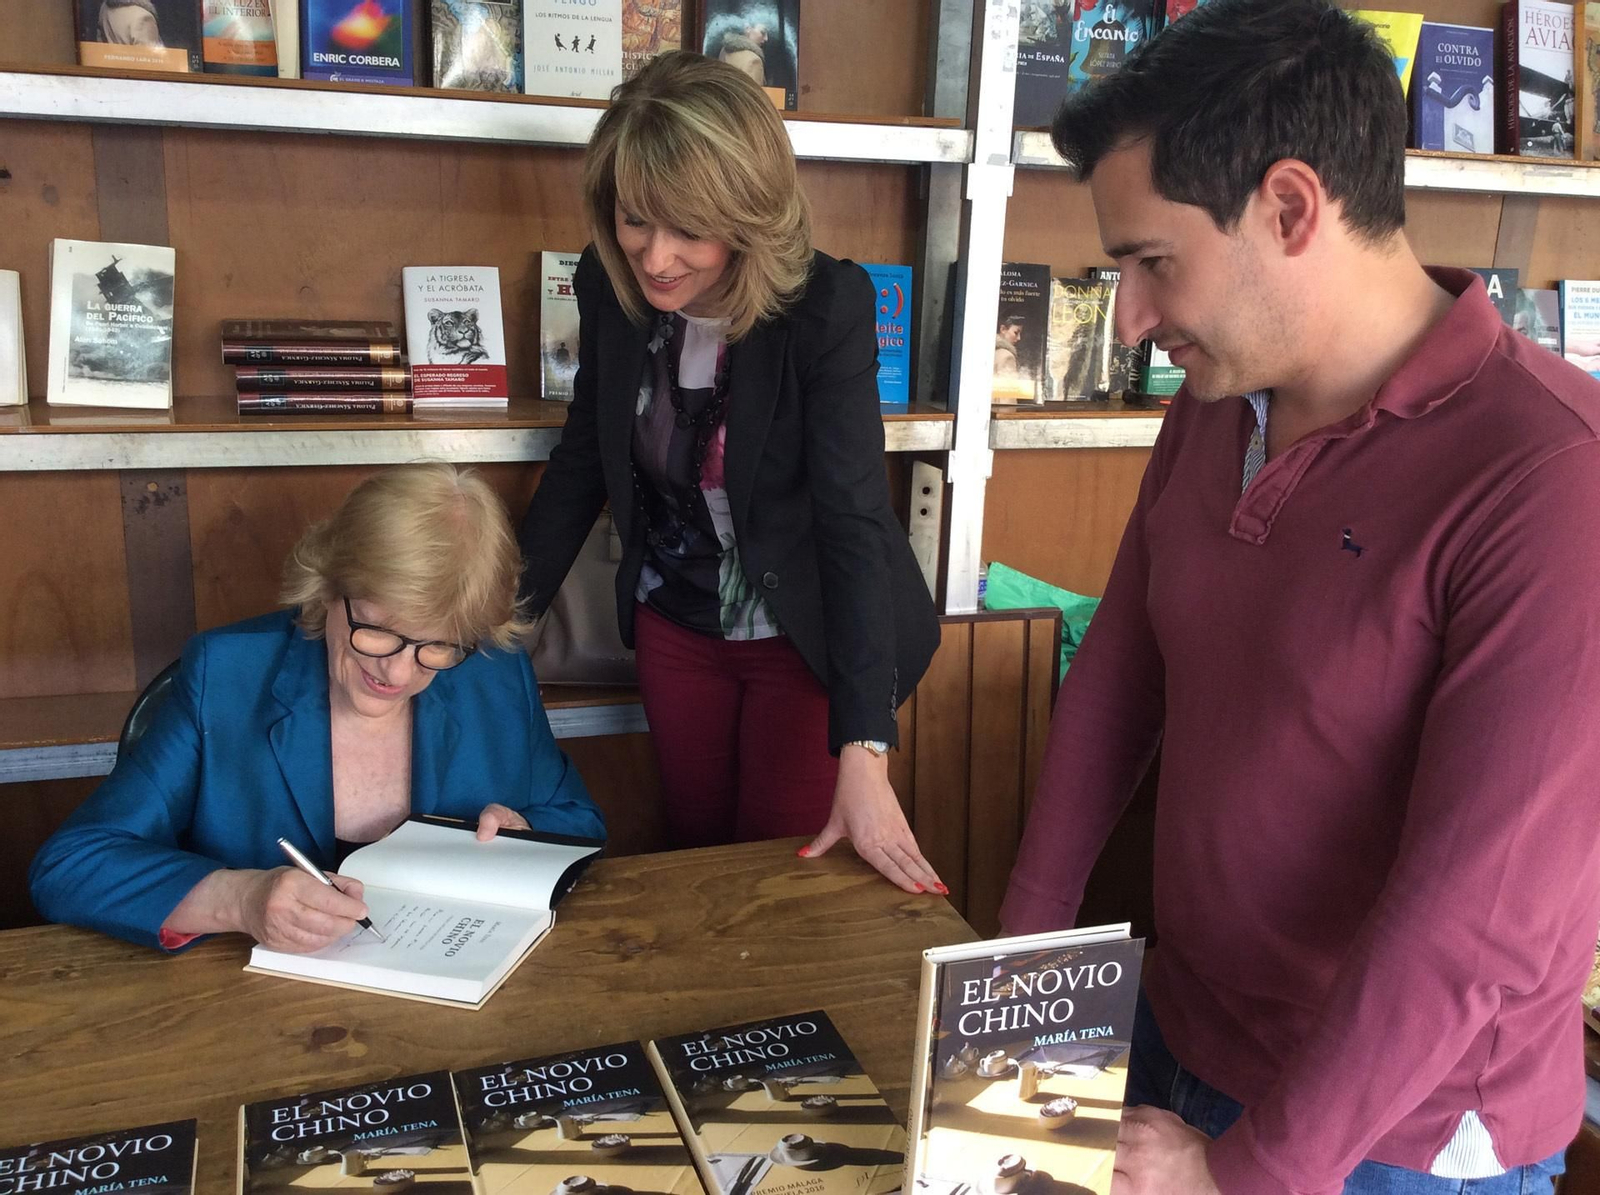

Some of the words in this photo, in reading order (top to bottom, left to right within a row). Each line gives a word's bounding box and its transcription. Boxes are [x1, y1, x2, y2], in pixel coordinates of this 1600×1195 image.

[1103, 4, 1117, 24] El
[1074, 20, 1139, 42] Encanto
[1525, 27, 1575, 51] AVIA
[1437, 42, 1480, 56] CONTRA
[313, 53, 347, 63] ENRIC
[348, 55, 400, 67] CORBERA
[554, 65, 586, 75] ANTONIO
[1443, 54, 1482, 67] OLVIDO
[1507, 65, 1515, 77] LA
[438, 283, 485, 292] ACRÓBATA
[439, 275, 475, 283] TIGRESA
[1053, 284, 1115, 300] DONNA
[86, 312, 104, 321] DEL
[108, 311, 153, 323] PACÍFICO
[104, 303, 143, 313] GUERRA
[1052, 303, 1108, 324] LEON
[1573, 311, 1582, 319] EL
[441, 917, 472, 945] CHINO
[470, 919, 485, 929] EL
[444, 929, 476, 958] NOVIO
[961, 978, 1001, 1006] EL
[1010, 961, 1122, 999] NOVIO
[958, 998, 1075, 1036] CHINO
[681, 1039, 718, 1057] EL
[720, 1021, 818, 1049] NOVIO
[1033, 1029, 1077, 1048] MARÍA
[1079, 1025, 1114, 1040] TENA
[690, 1043, 789, 1072] CHINO
[765, 1059, 802, 1073] MARÍA
[803, 1053, 836, 1064] TENA
[479, 1073, 518, 1091] EL
[523, 1053, 628, 1083] NOVIO
[484, 1077, 593, 1107] CHINO
[563, 1094, 603, 1108] MARÍA
[606, 1087, 641, 1099] TENA
[271, 1106, 311, 1124] EL
[320, 1083, 432, 1116] NOVIO
[271, 1109, 390, 1141] CHINO
[353, 1126, 398, 1141] MARÍA
[401, 1119, 438, 1132] TENA
[46, 1134, 173, 1168] NOVIO
[74, 1182, 124, 1195] MARÍA
[128, 1175, 169, 1188] TENA
[787, 1177, 824, 1190] MÁLAGA
[805, 1185, 825, 1194] 2016
